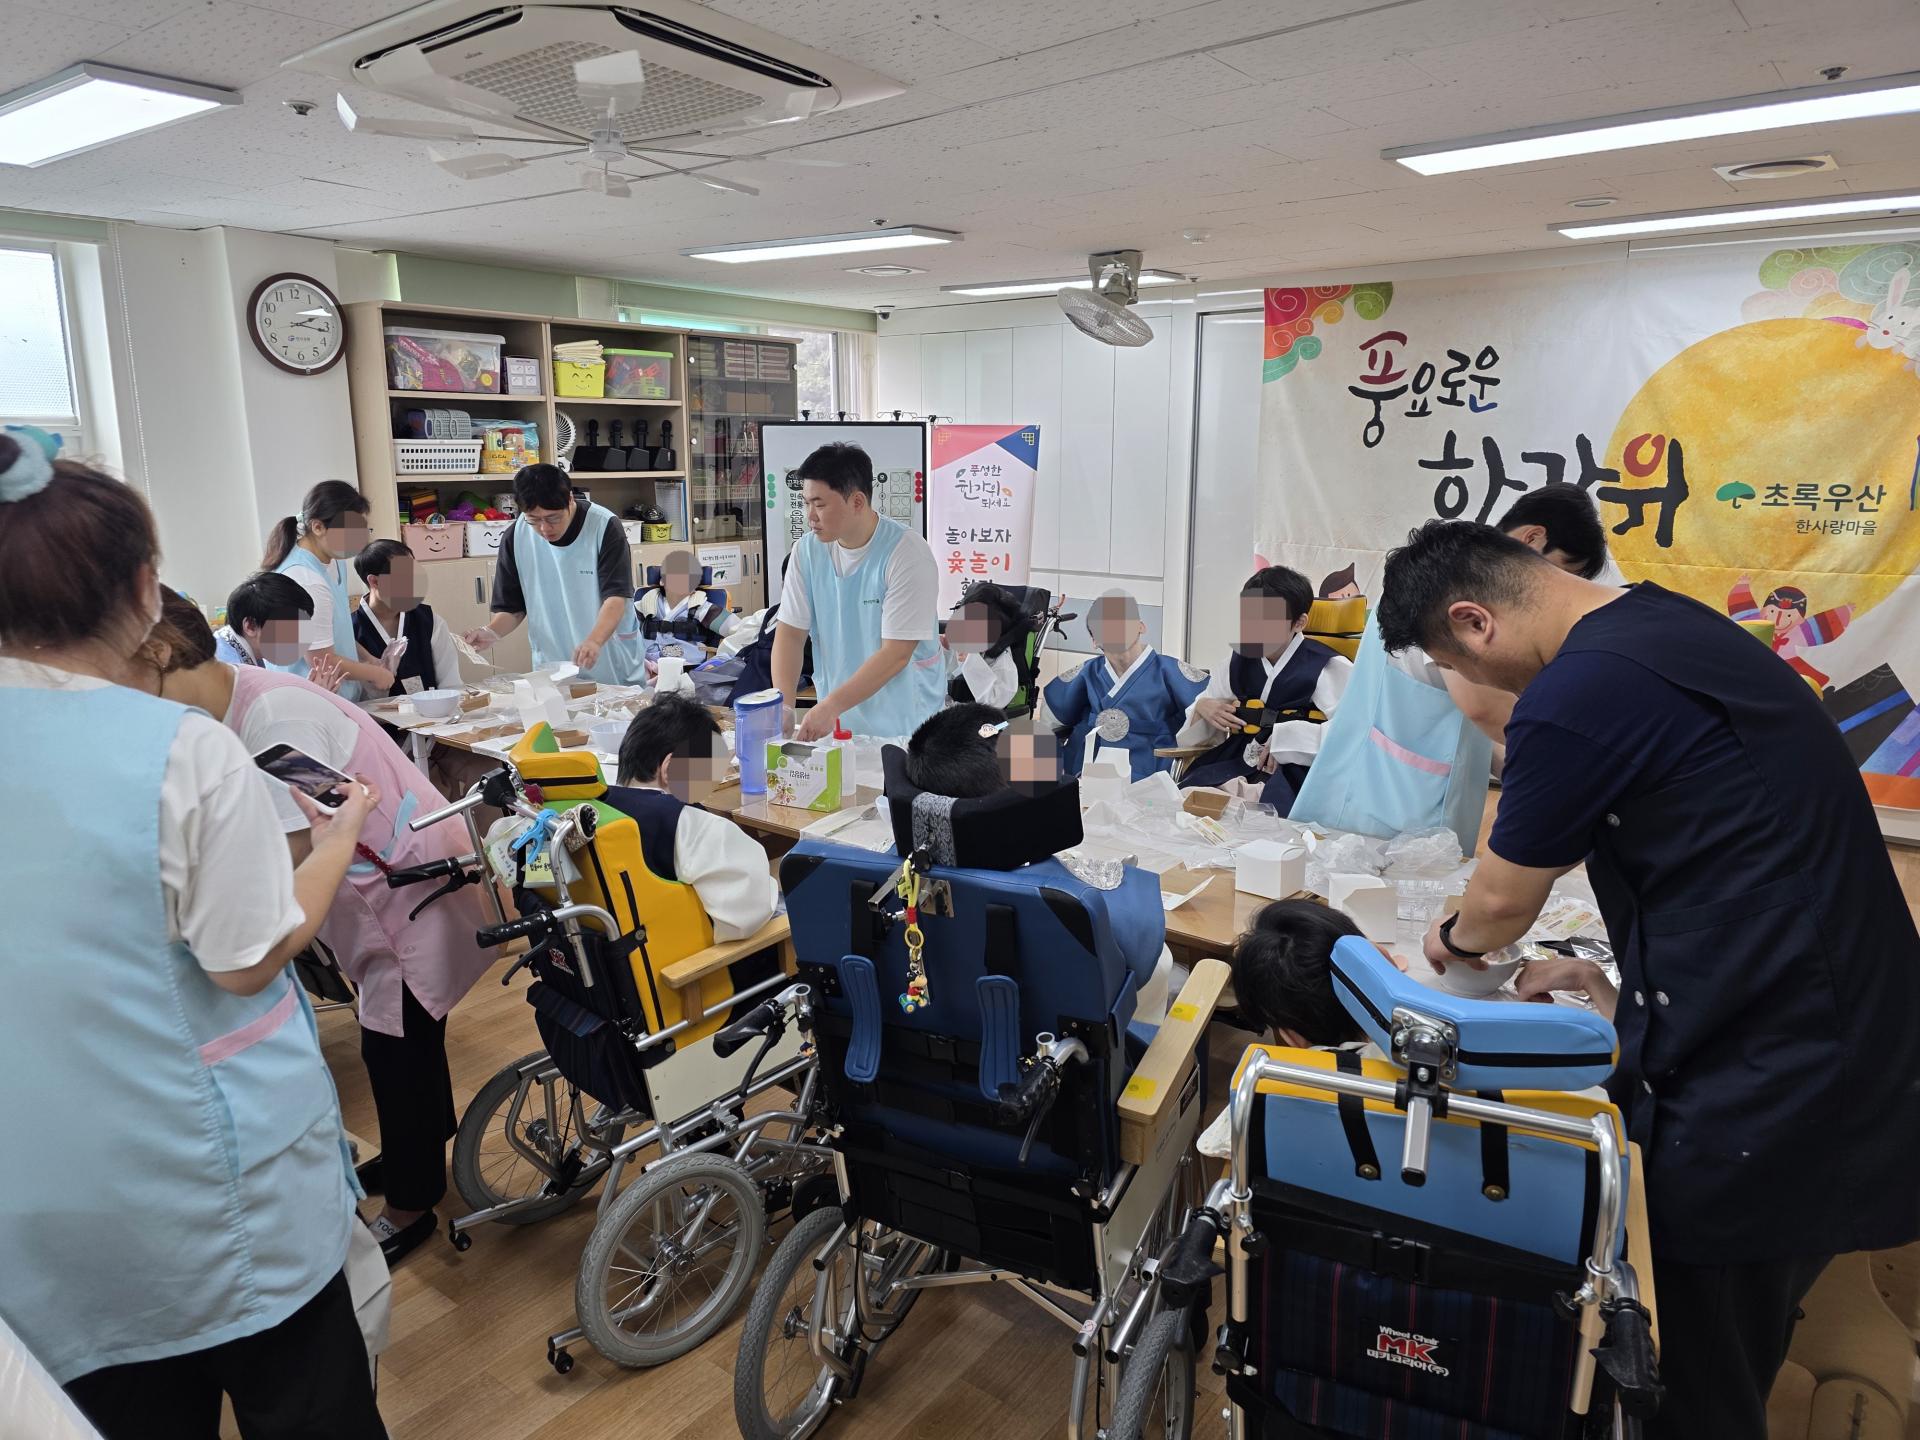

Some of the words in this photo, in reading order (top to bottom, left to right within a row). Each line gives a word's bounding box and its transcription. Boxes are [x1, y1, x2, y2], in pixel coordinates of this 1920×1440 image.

[275, 291, 284, 303] 11
[290, 288, 300, 300] 12
[307, 294, 312, 304] 1
[264, 302, 276, 313] 10
[264, 317, 272, 328] 9
[270, 332, 278, 344] 8
[319, 337, 327, 347] 4
[281, 345, 289, 356] 7
[297, 350, 305, 361] 6
[312, 346, 320, 358] 5
[1347, 330, 1501, 449] 풍요로운
[969, 464, 1002, 477] 풍성한
[955, 479, 1002, 500] 한가위
[981, 497, 1012, 509] 되세요
[1761, 483, 1887, 513] 초록우산
[1795, 519, 1878, 536] 한사랑마을
[945, 526, 1012, 545] 놀아보자
[947, 550, 1011, 574] 윷놀이
[1379, 1325, 1411, 1339] Wheel
[1412, 1334, 1440, 1346] Chair
[1376, 1333, 1439, 1365] MK
